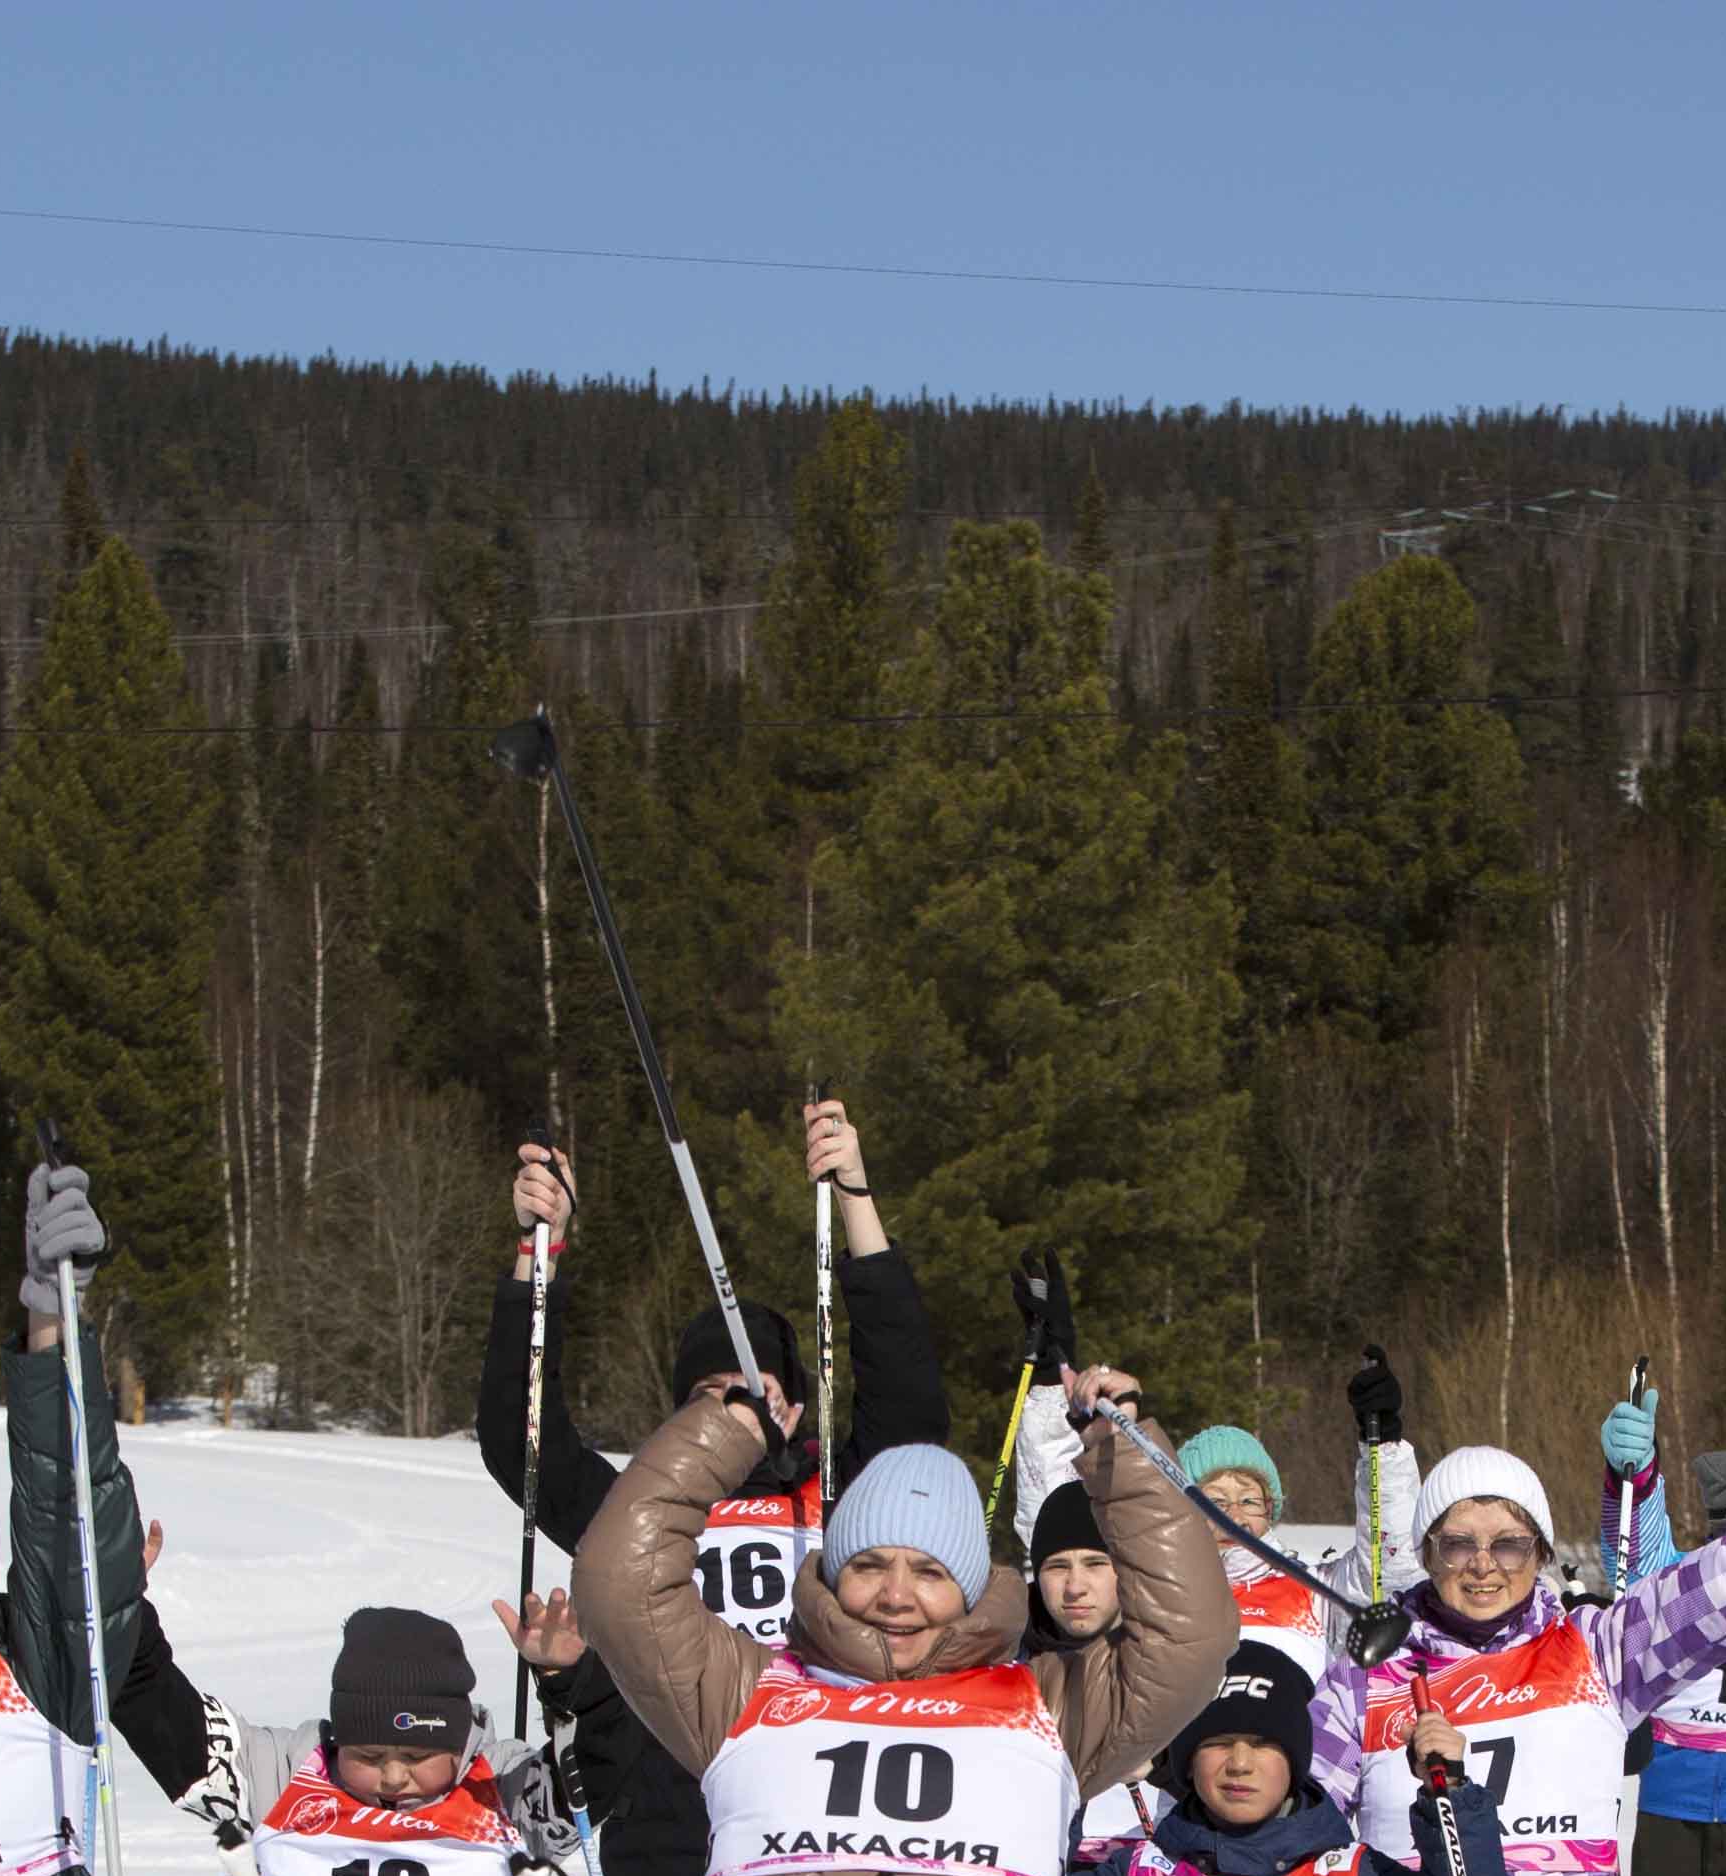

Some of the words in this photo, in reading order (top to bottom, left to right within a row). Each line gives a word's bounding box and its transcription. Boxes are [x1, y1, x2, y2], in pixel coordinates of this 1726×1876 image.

[695, 1541, 785, 1613] 16
[1616, 1536, 1631, 1593] LEKI
[394, 1712, 447, 1730] Champion
[1451, 1674, 1540, 1714] Тёя
[816, 1741, 954, 1822] 10
[1471, 1736, 1516, 1806] 7
[762, 1831, 999, 1868] ХАКАСИЯ
